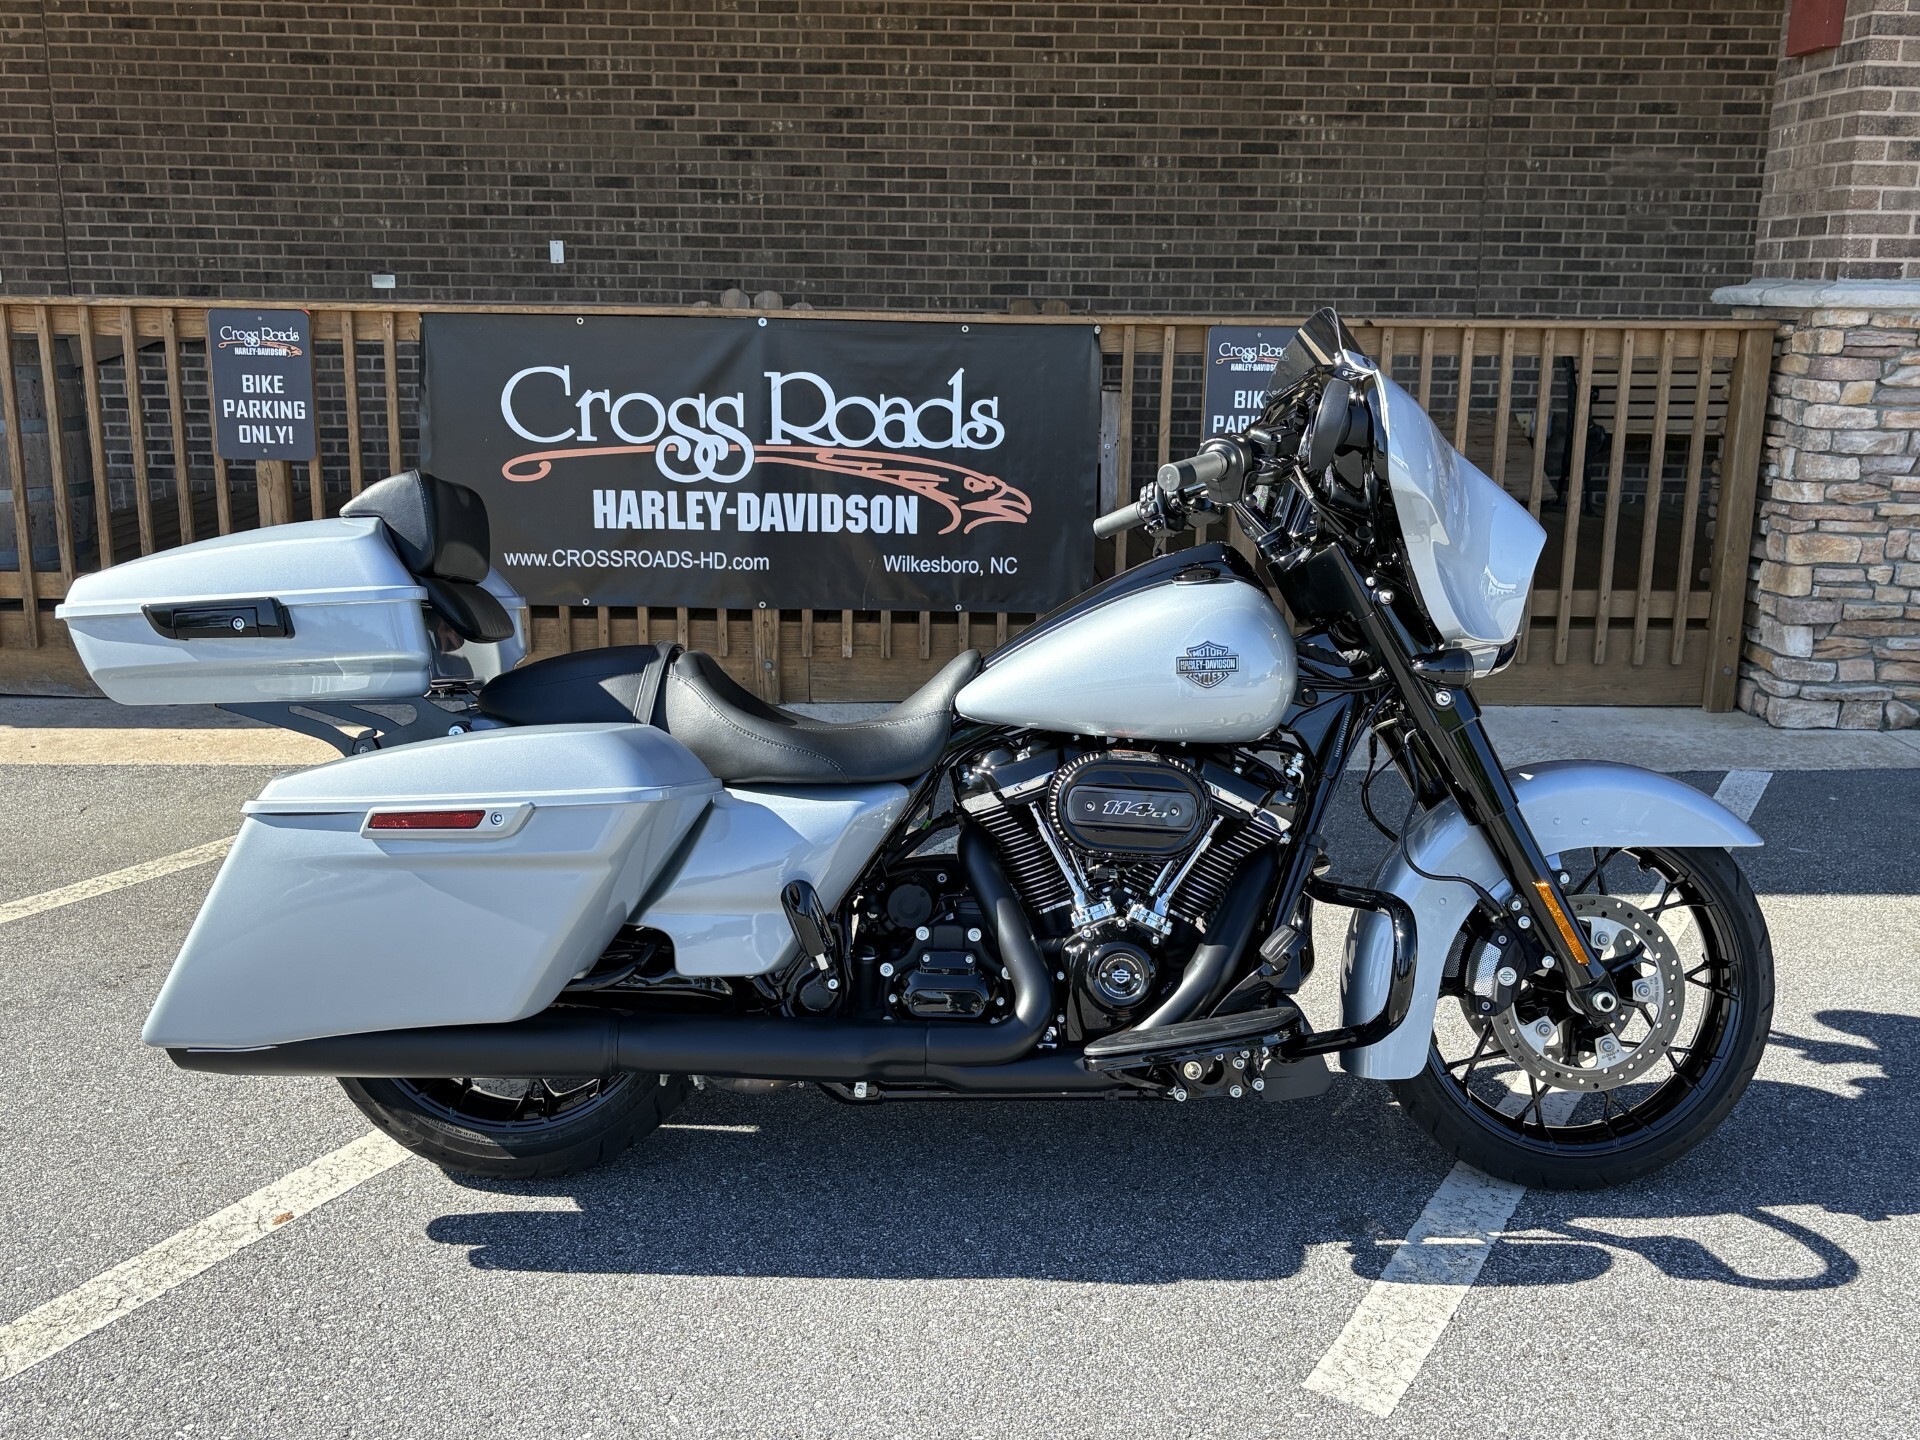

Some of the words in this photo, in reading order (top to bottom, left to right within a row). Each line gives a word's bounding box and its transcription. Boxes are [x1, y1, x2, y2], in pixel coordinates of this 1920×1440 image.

[220, 326, 260, 346] Cross
[261, 327, 299, 341] Roads
[234, 347, 287, 356] HARLEY-DAVIDSON
[1219, 342, 1257, 362] Cross
[241, 374, 285, 394] BIKE
[222, 399, 306, 420] PARKING
[1234, 390, 1267, 409] BIK
[501, 365, 755, 483] Cross
[763, 367, 1006, 450] Roads
[238, 425, 294, 445] ONLY!
[593, 489, 919, 534] HARLEY-DAVIDSON
[504, 549, 770, 571] www.CROSSROADS-HD.com
[883, 554, 985, 577] Wilkesboro,
[990, 557, 1018, 574] NC
[1192, 647, 1224, 657] MOTOR
[1180, 658, 1236, 671] HARLEY-DAVIDSON
